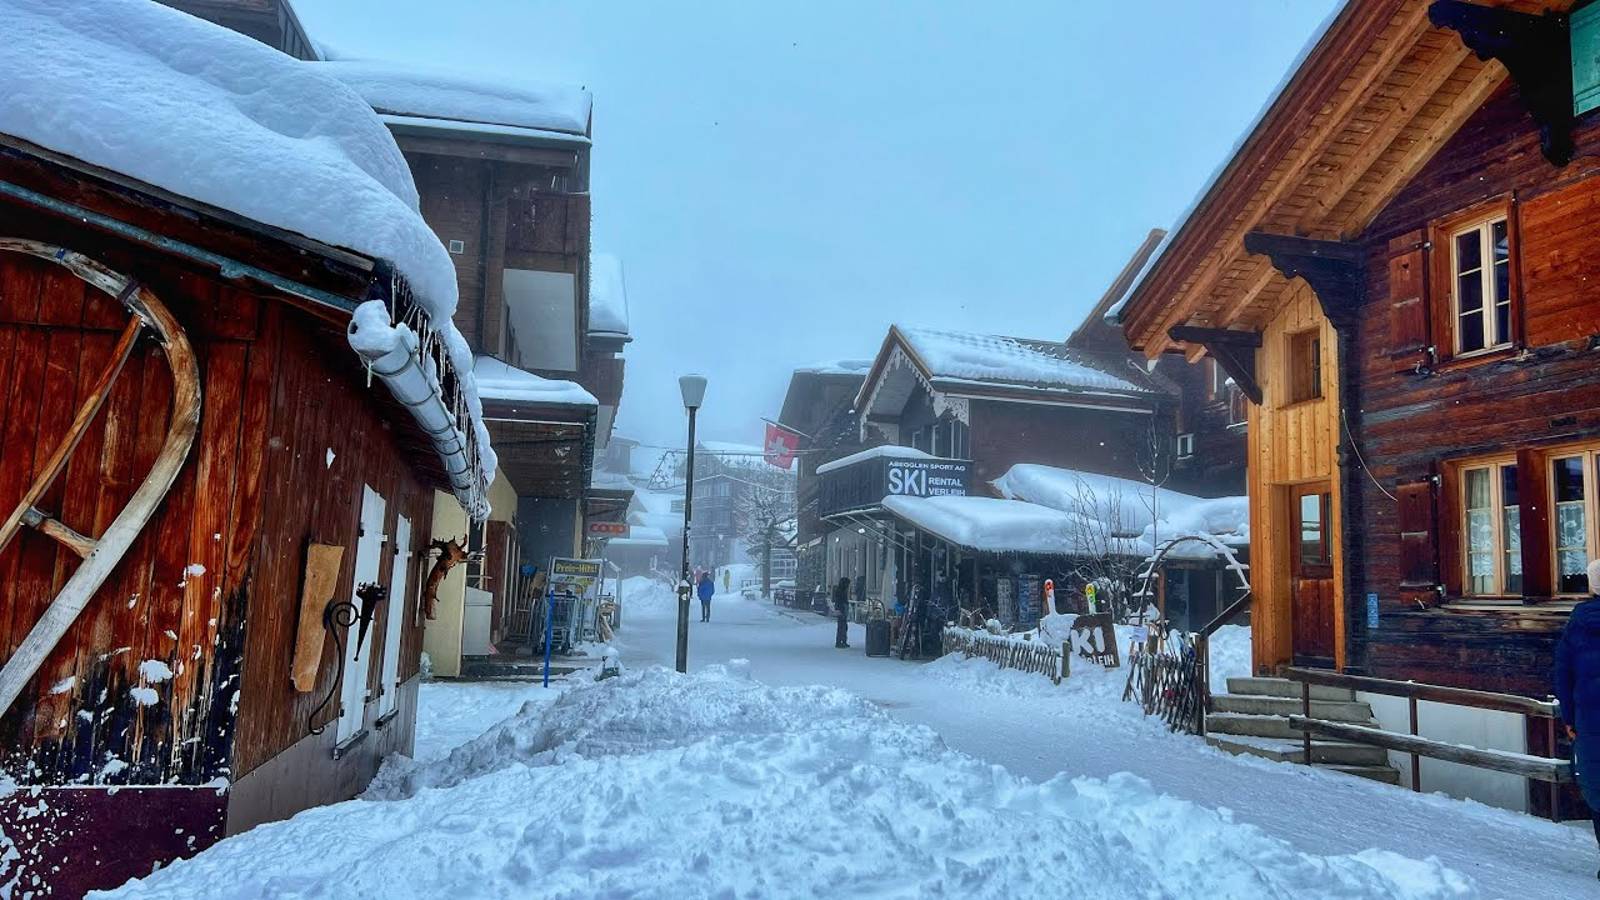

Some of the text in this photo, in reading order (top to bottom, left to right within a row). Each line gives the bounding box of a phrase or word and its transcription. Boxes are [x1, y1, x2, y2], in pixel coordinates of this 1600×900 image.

[930, 463, 954, 471] SPORT
[888, 468, 926, 495] SKI
[928, 477, 963, 486] RENTAL
[928, 487, 966, 496] VERLEIH
[1071, 626, 1105, 655] KI
